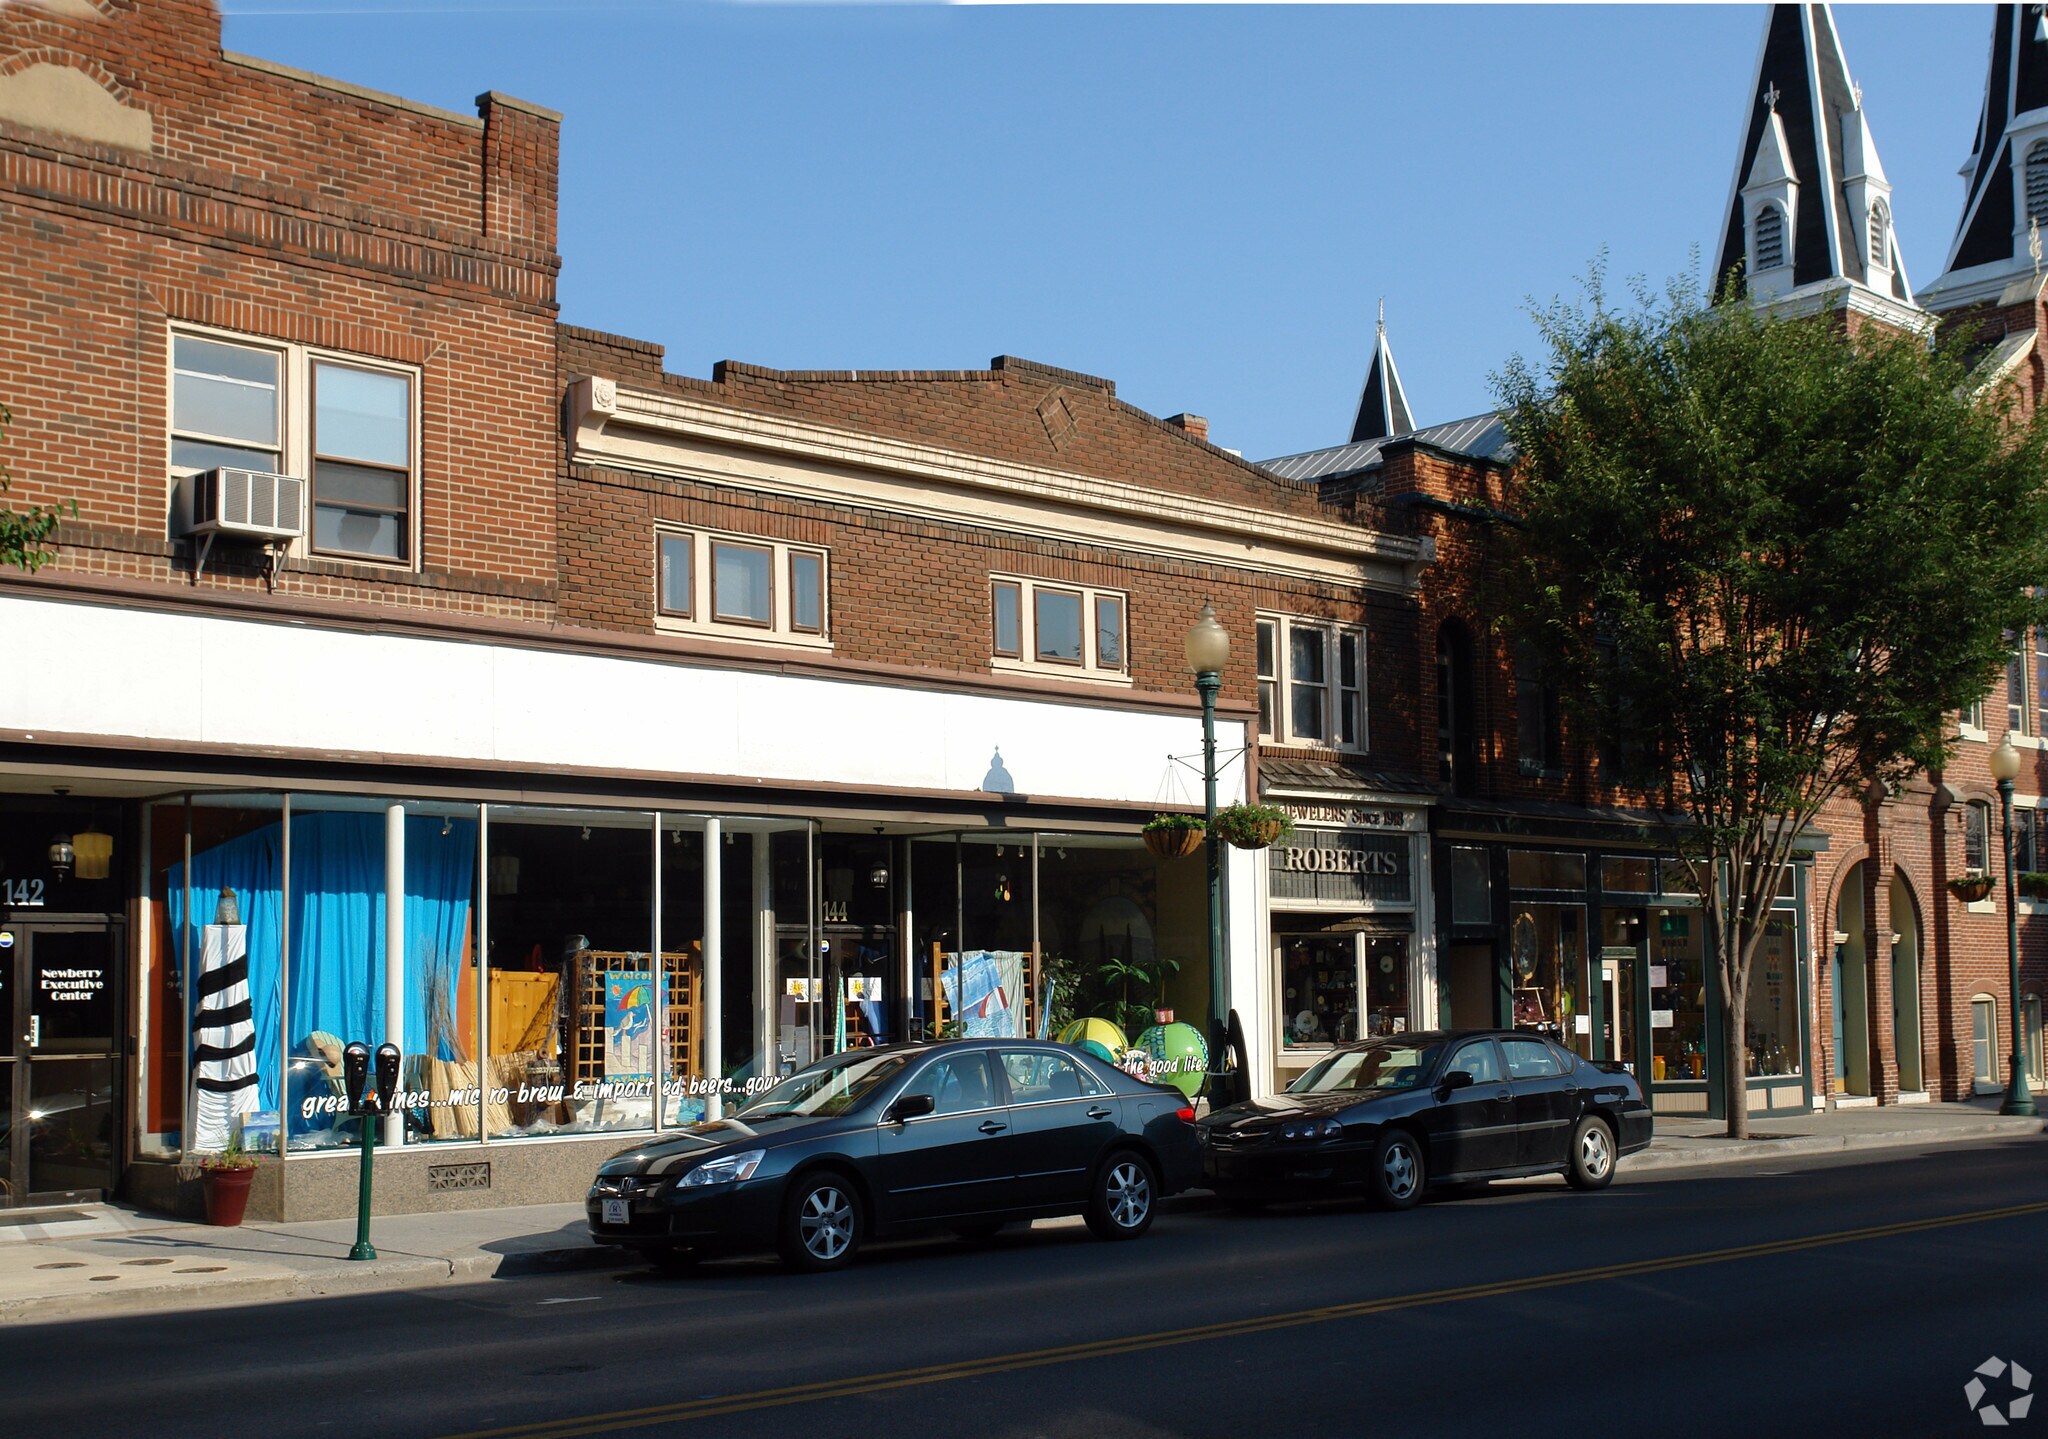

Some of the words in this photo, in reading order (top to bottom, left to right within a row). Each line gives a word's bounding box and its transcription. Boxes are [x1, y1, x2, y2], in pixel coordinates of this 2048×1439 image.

[1286, 846, 1398, 875] ROBERTS
[3, 878, 45, 906] 142
[822, 901, 848, 921] 144
[41, 969, 103, 979] Newberry
[41, 980, 104, 990] Executive
[51, 991, 94, 1001] Center
[302, 1094, 353, 1119] grea
[573, 1080, 585, 1101] &
[1124, 1056, 1144, 1074] the
[1150, 1055, 1180, 1077] good
